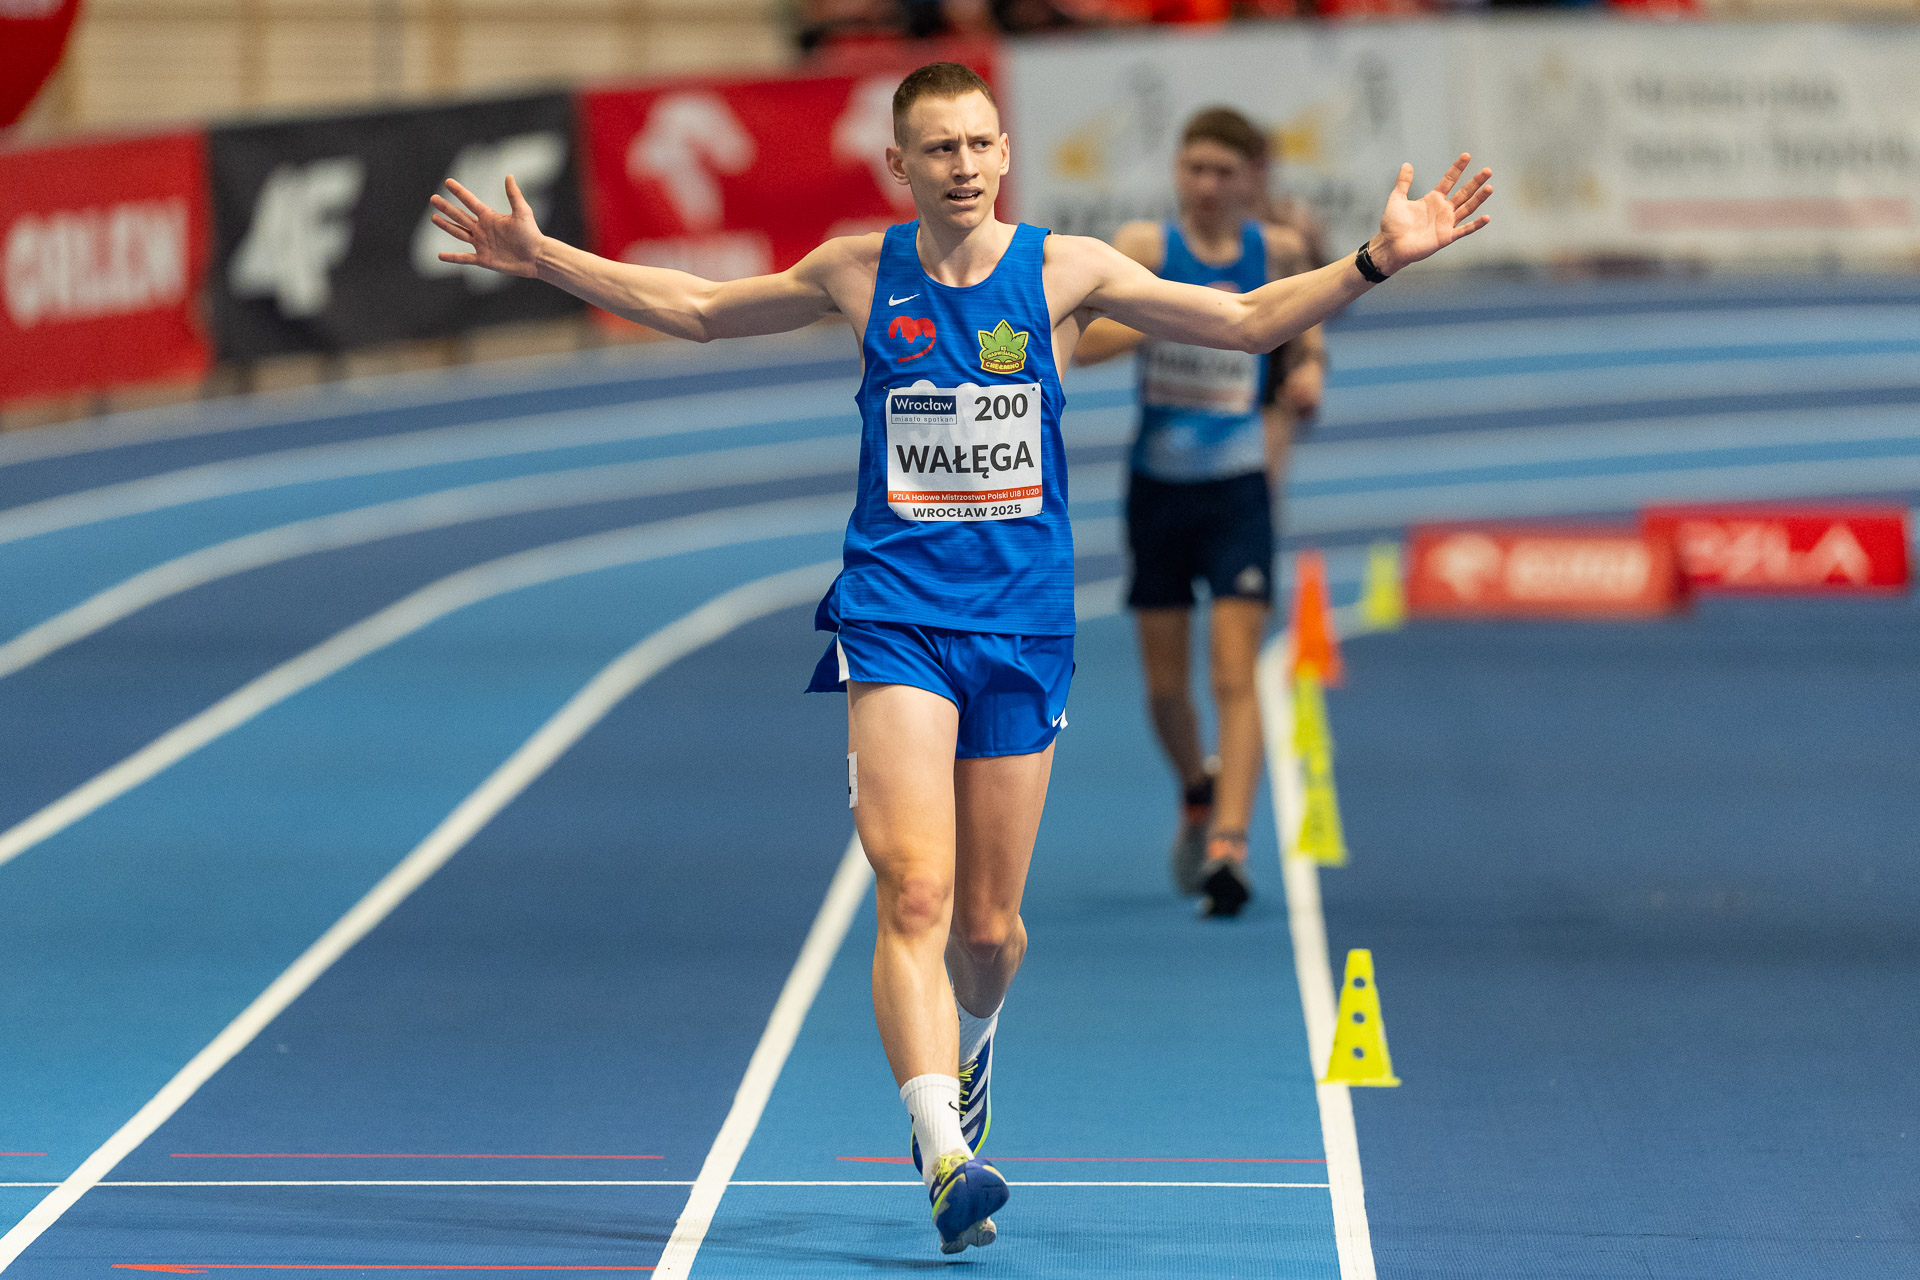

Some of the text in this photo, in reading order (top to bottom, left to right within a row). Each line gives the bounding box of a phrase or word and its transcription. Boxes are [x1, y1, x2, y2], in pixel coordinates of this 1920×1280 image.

[230, 153, 364, 318] 4F
[894, 397, 953, 411] Wrocław
[974, 393, 1029, 422] 200
[894, 415, 921, 423] miasto
[896, 441, 1034, 479] WAŁĘGA
[892, 493, 910, 501] PZLA
[987, 491, 1009, 500] Polski
[1009, 490, 1022, 498] U18
[1025, 487, 1040, 496] U20
[912, 503, 1022, 518] WROCŁAW 2025
